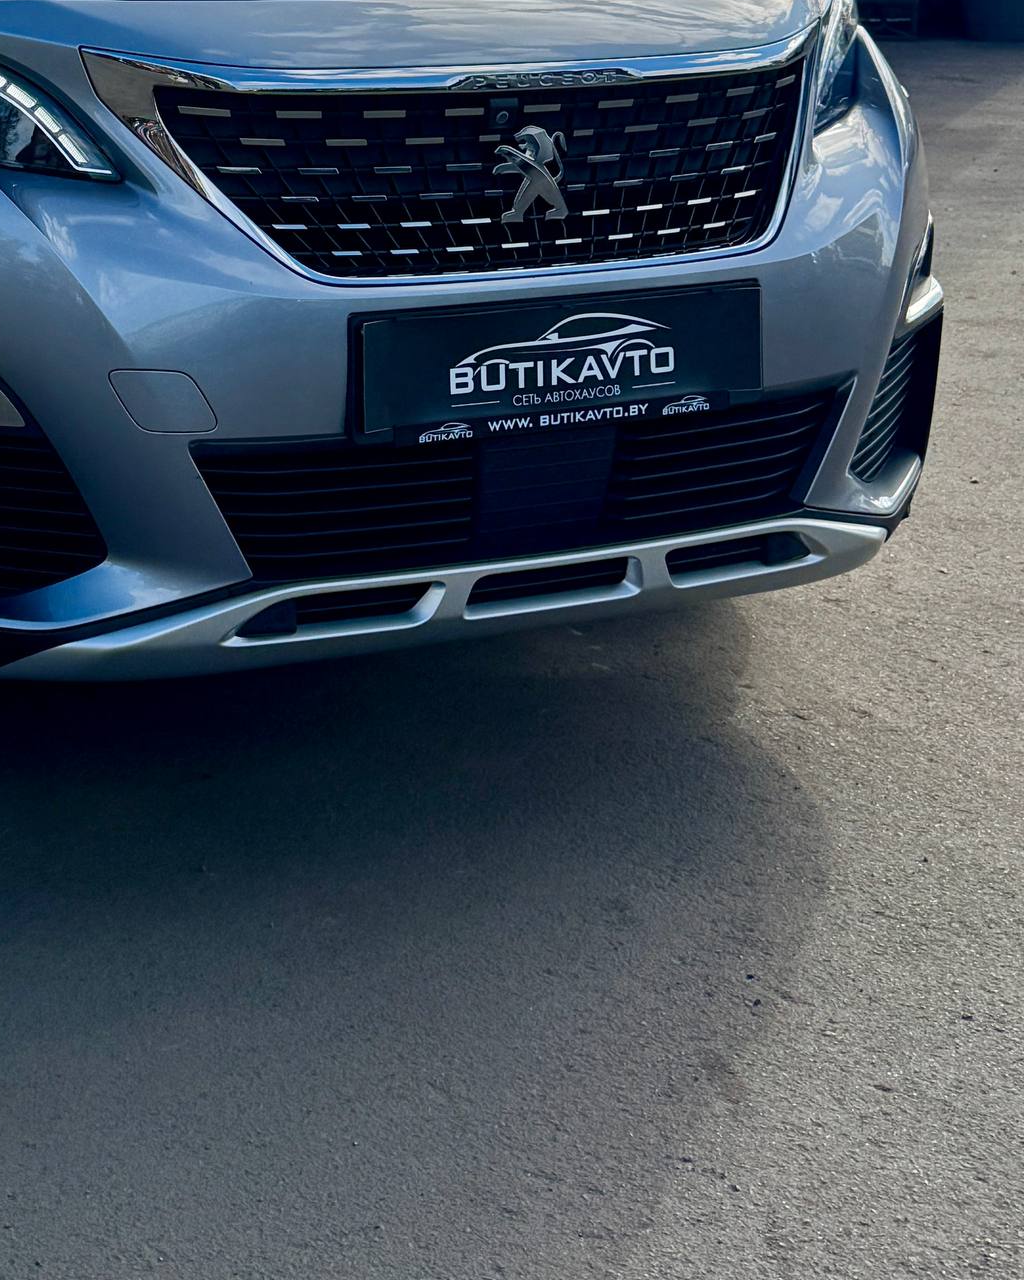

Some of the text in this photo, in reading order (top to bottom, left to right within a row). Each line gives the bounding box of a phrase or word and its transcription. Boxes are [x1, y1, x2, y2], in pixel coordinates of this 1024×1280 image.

[449, 346, 675, 395] BUTIKAVTO
[512, 384, 622, 407] СЕТЬ АВТОХАУСОВ
[487, 403, 649, 433] WWW. BUTIKAVTO.BY
[662, 402, 711, 417] BUTIKAVTO
[418, 430, 474, 444] BUTIKAVTO
